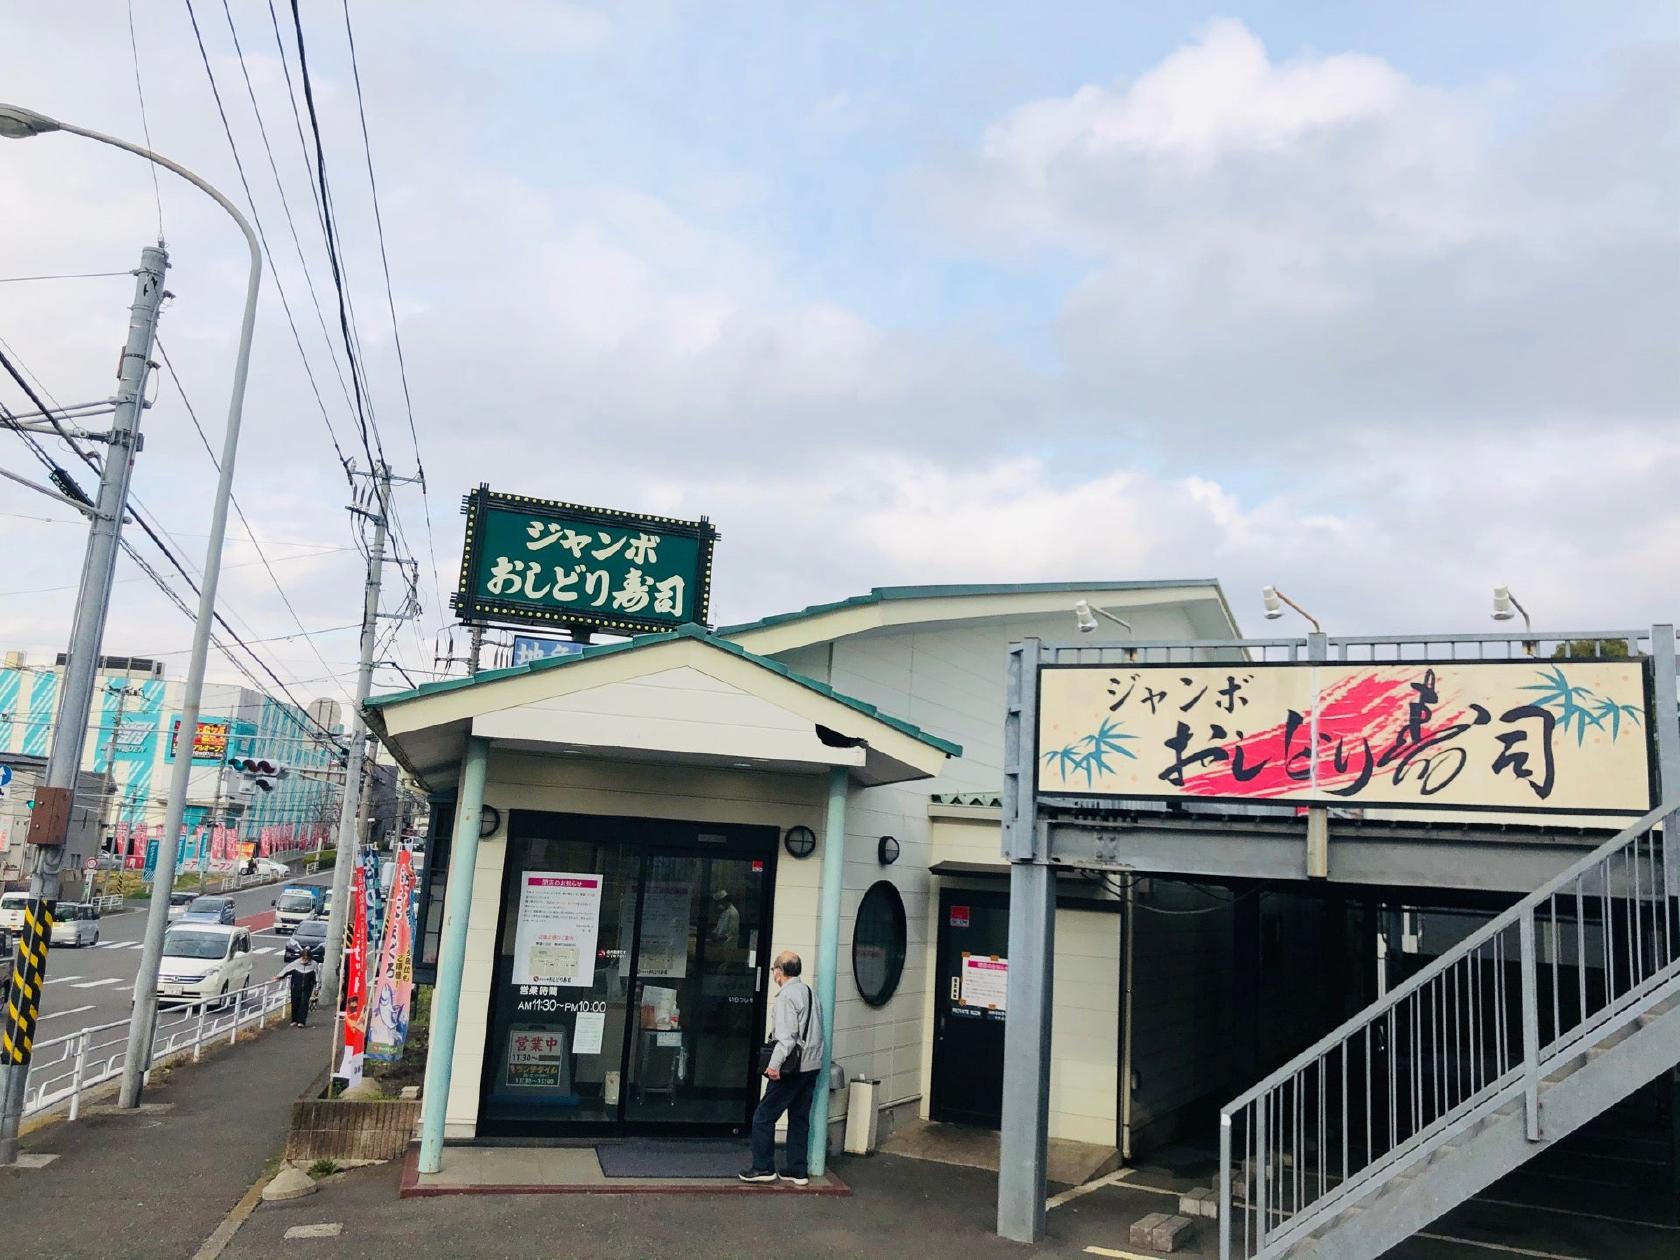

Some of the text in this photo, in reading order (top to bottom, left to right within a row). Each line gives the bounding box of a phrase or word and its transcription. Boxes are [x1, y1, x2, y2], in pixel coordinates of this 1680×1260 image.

[526, 520, 661, 565] ジャンボ
[486, 556, 686, 618] おしどり寿司
[1105, 673, 1257, 715] ジャンボ
[1157, 667, 1556, 801] おしどり寿司
[519, 985, 559, 996] 営業時間
[514, 1035, 559, 1053] 営業中
